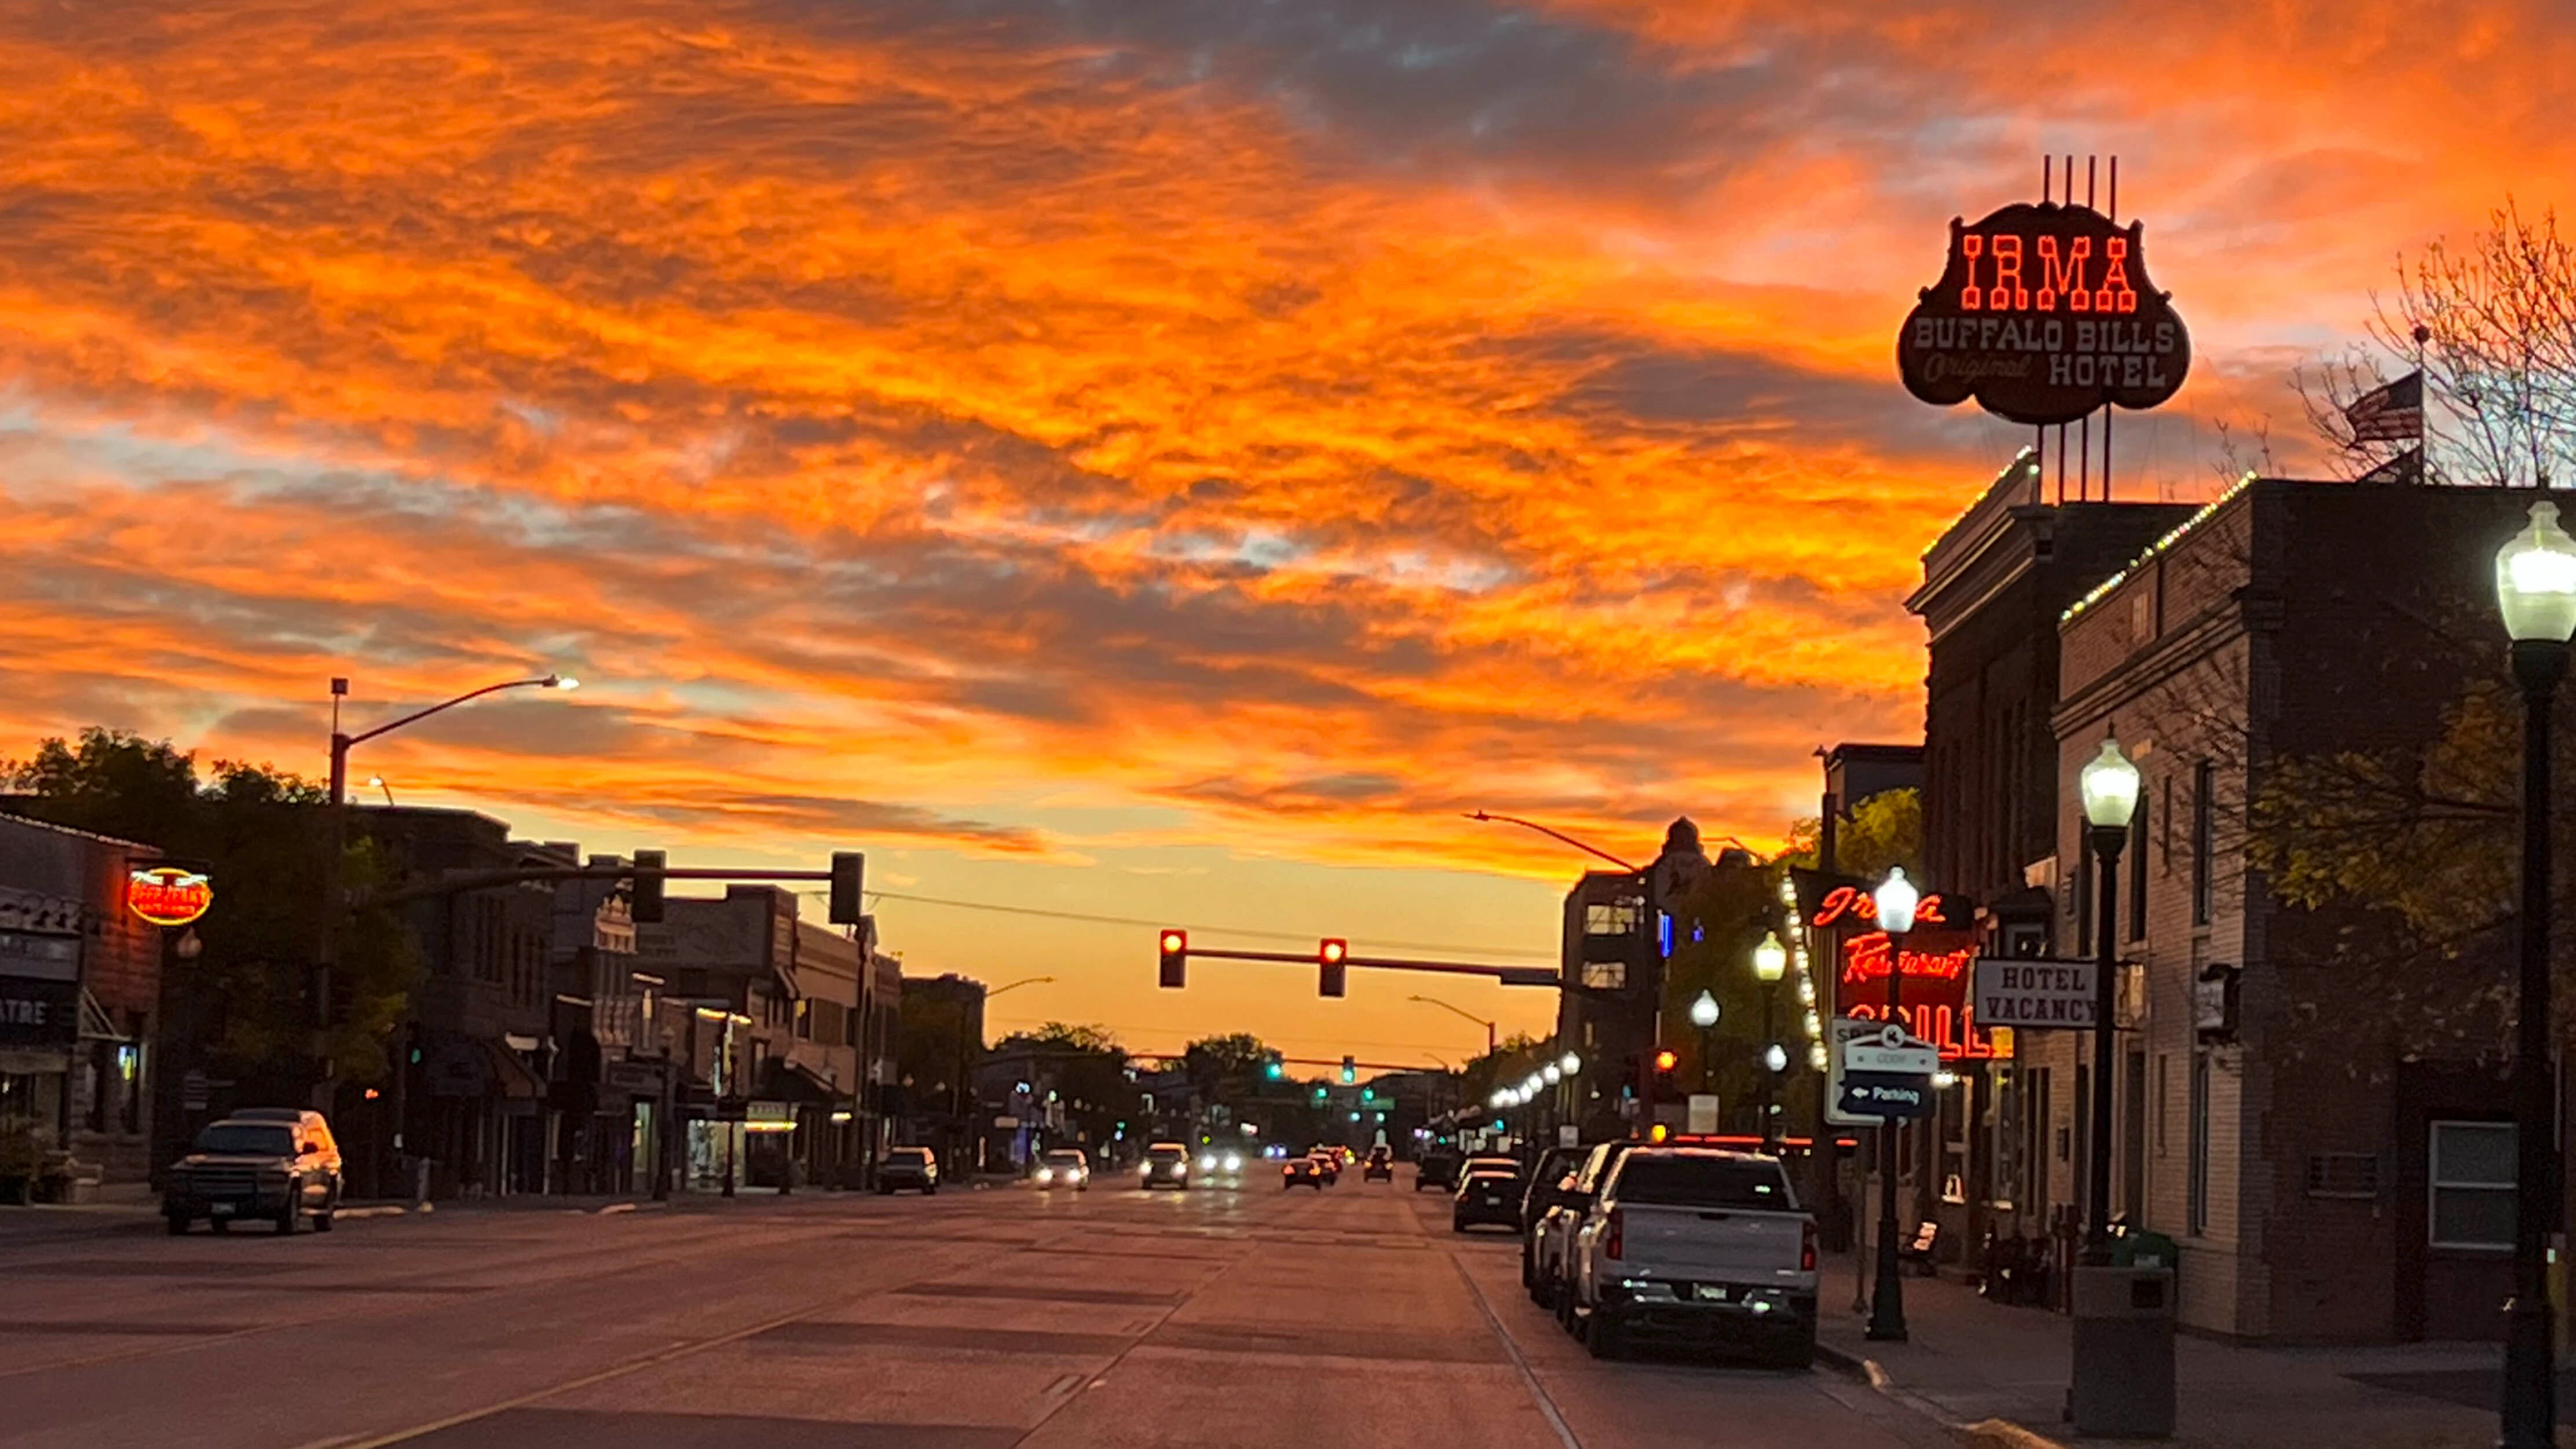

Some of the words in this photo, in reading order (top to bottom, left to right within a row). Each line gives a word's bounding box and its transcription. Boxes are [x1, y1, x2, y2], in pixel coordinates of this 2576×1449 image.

[1962, 235, 2137, 313] IRMA
[1913, 317, 2063, 352] BUFFALO
[2075, 320, 2175, 354] BILLS
[2048, 355, 2166, 387] HOTEL
[1813, 886, 1946, 926] Ira
[2001, 967, 2085, 991] HOTEL
[1986, 997, 2098, 1022] VACANCY
[1849, 1004, 1990, 1058] ILL
[1872, 1086, 1920, 1106] Parking
